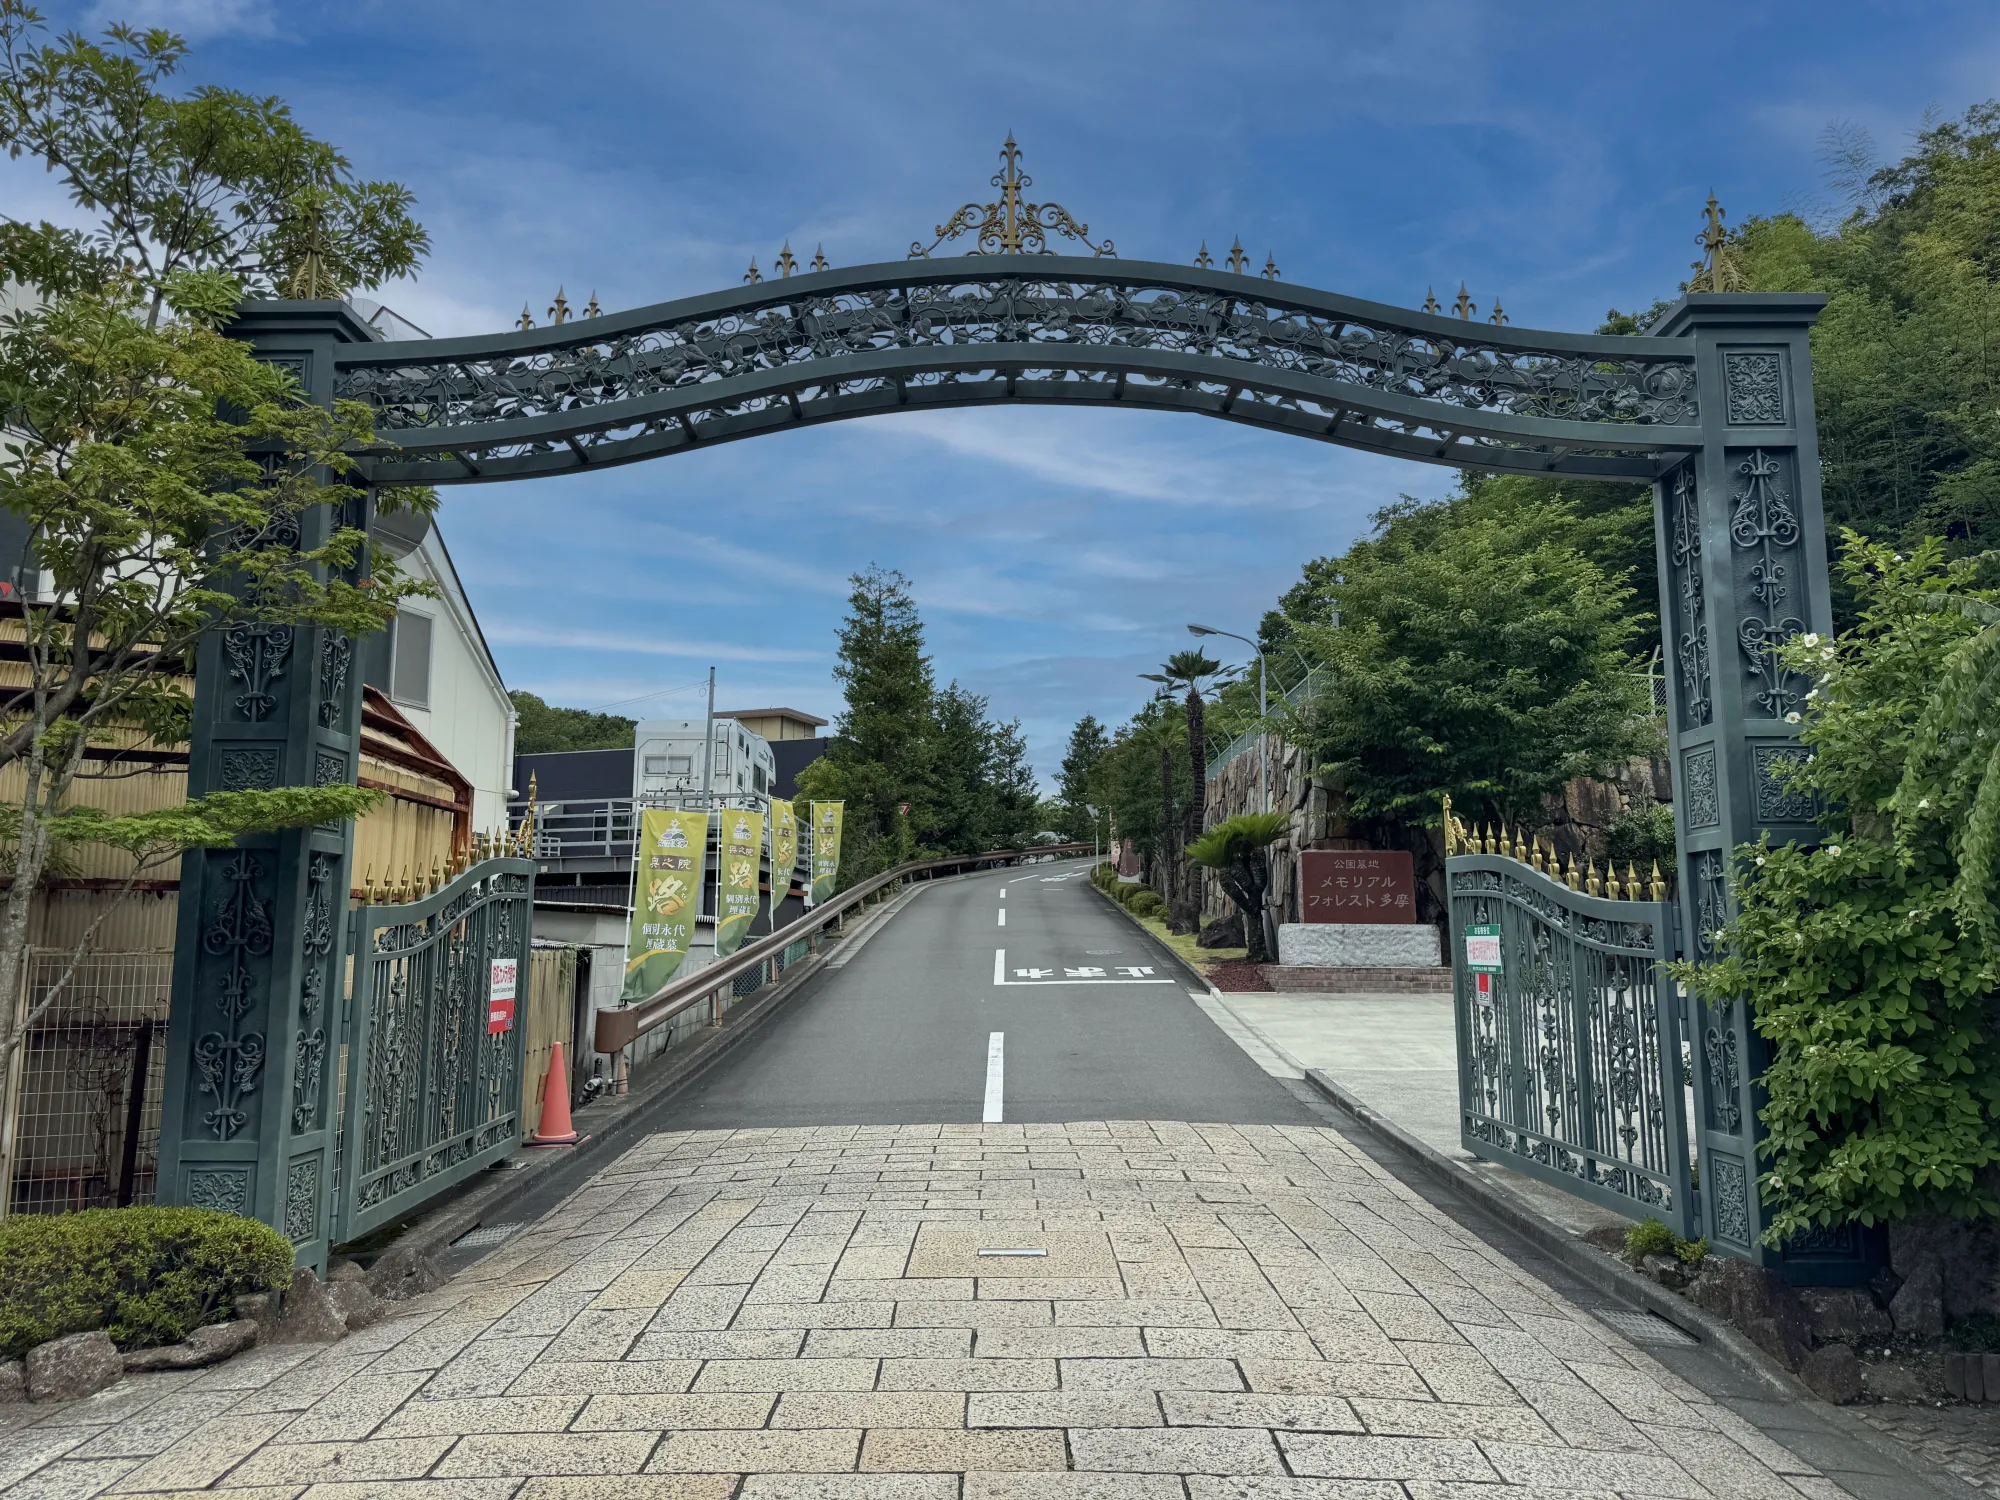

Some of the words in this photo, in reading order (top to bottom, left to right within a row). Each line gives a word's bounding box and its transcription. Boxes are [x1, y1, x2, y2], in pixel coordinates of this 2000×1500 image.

[650, 856, 692, 870] 奥之院
[1333, 859, 1380, 869] 公園墓地
[1321, 876, 1396, 888] メモリアル
[1309, 893, 1410, 908] フォレスト多摩
[1013, 966, 1155, 979] 止まれ
